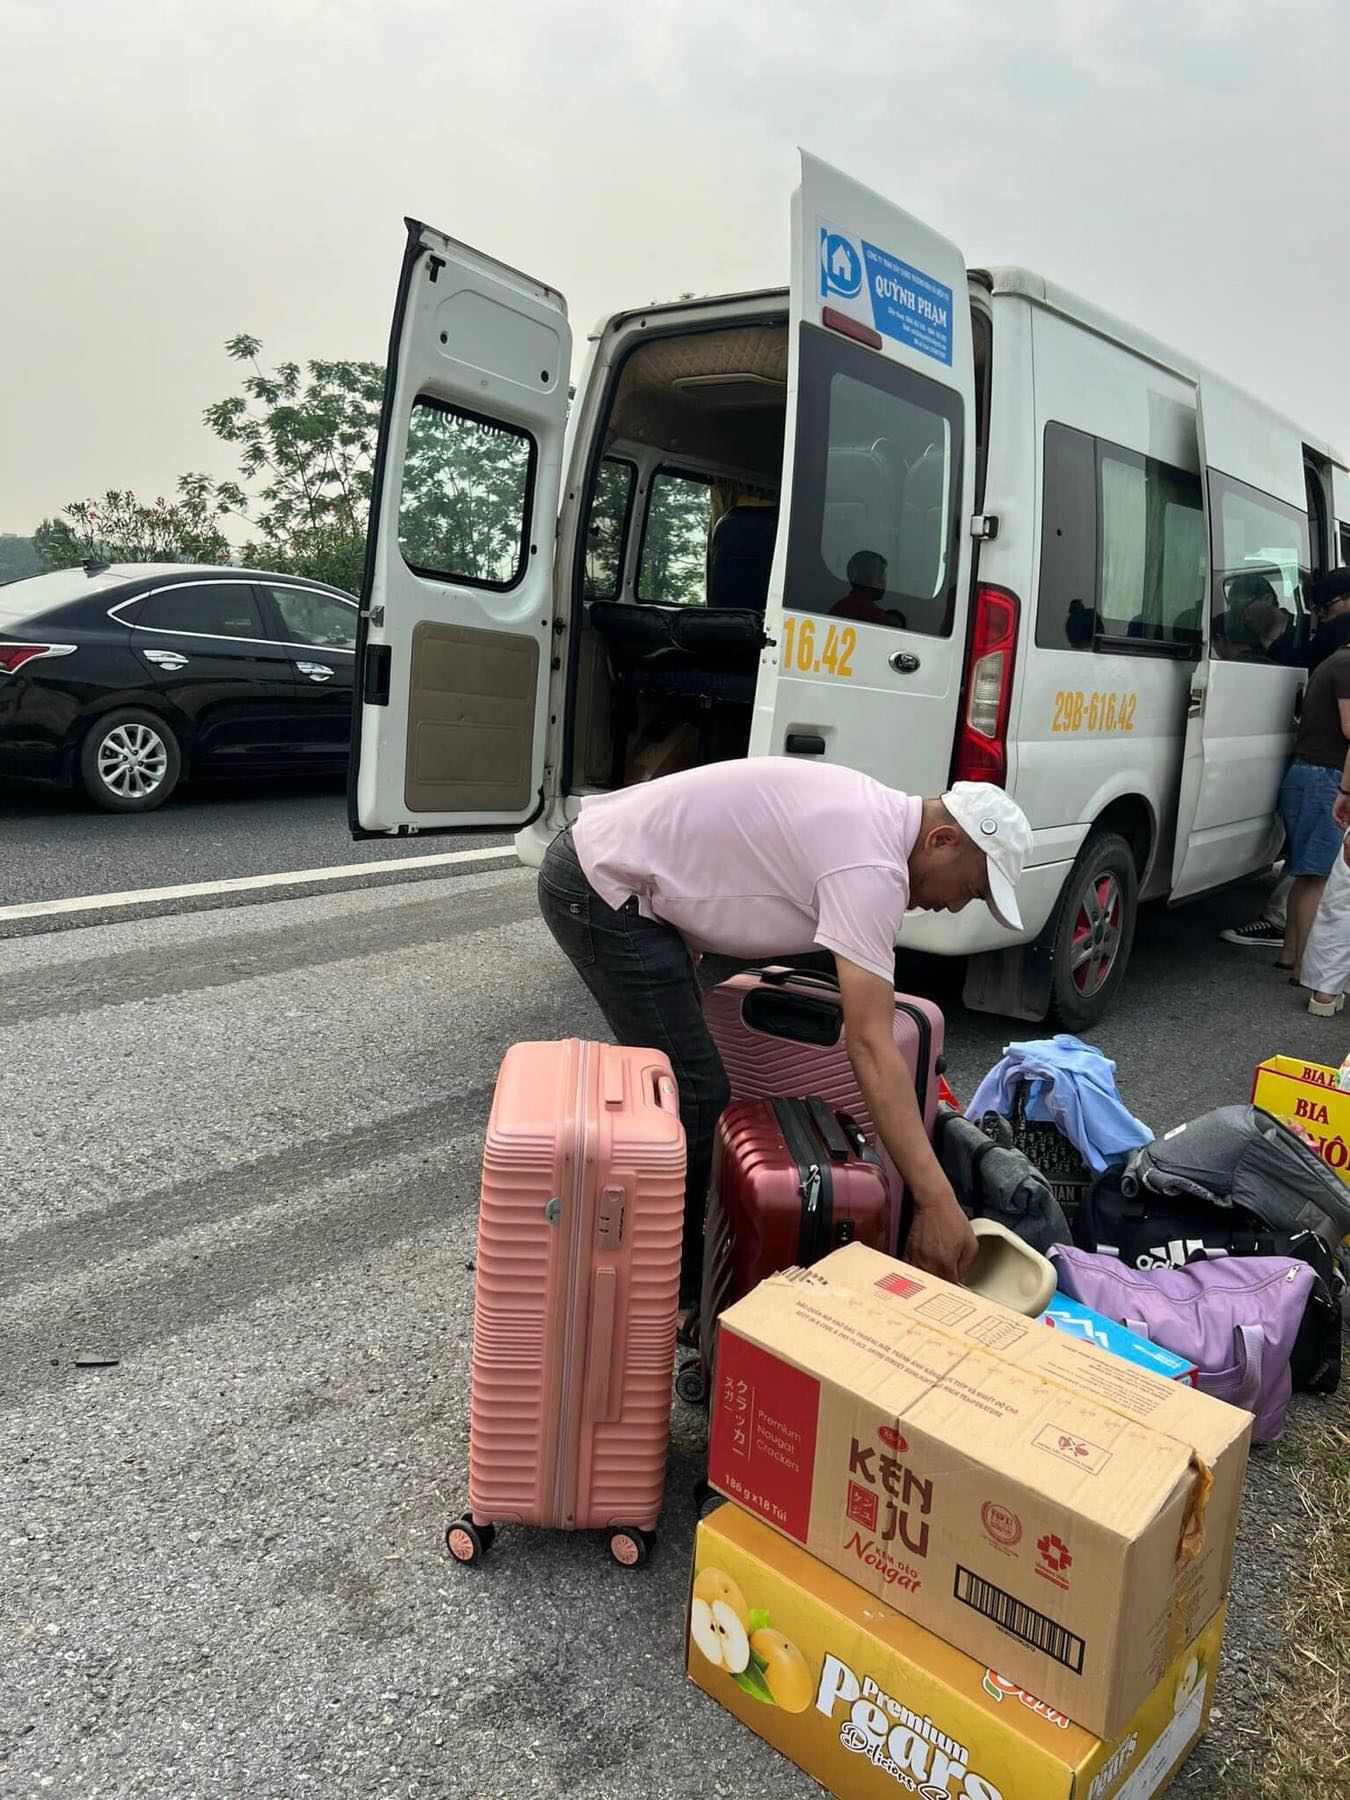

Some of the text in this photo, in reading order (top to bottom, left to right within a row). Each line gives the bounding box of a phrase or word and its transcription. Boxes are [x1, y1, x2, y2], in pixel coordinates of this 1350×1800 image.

[918, 295, 947, 328] PHẠM
[784, 617, 857, 677] 16.42
[1052, 691, 1136, 732] 29B-616.42
[1302, 1066, 1337, 1088] BIA H
[1294, 1098, 1329, 1125] BIA
[732, 1380, 748, 1456] クラッカー
[758, 1409, 801, 1443] Premium
[756, 1439, 800, 1473] Crackers
[757, 1424, 795, 1454] Nougat
[725, 1474, 742, 1493] 186
[743, 1487, 751, 1500] g
[843, 1531, 923, 1593] Nougat
[862, 1674, 970, 1767] Premium
[840, 1720, 916, 1792] Delicious
